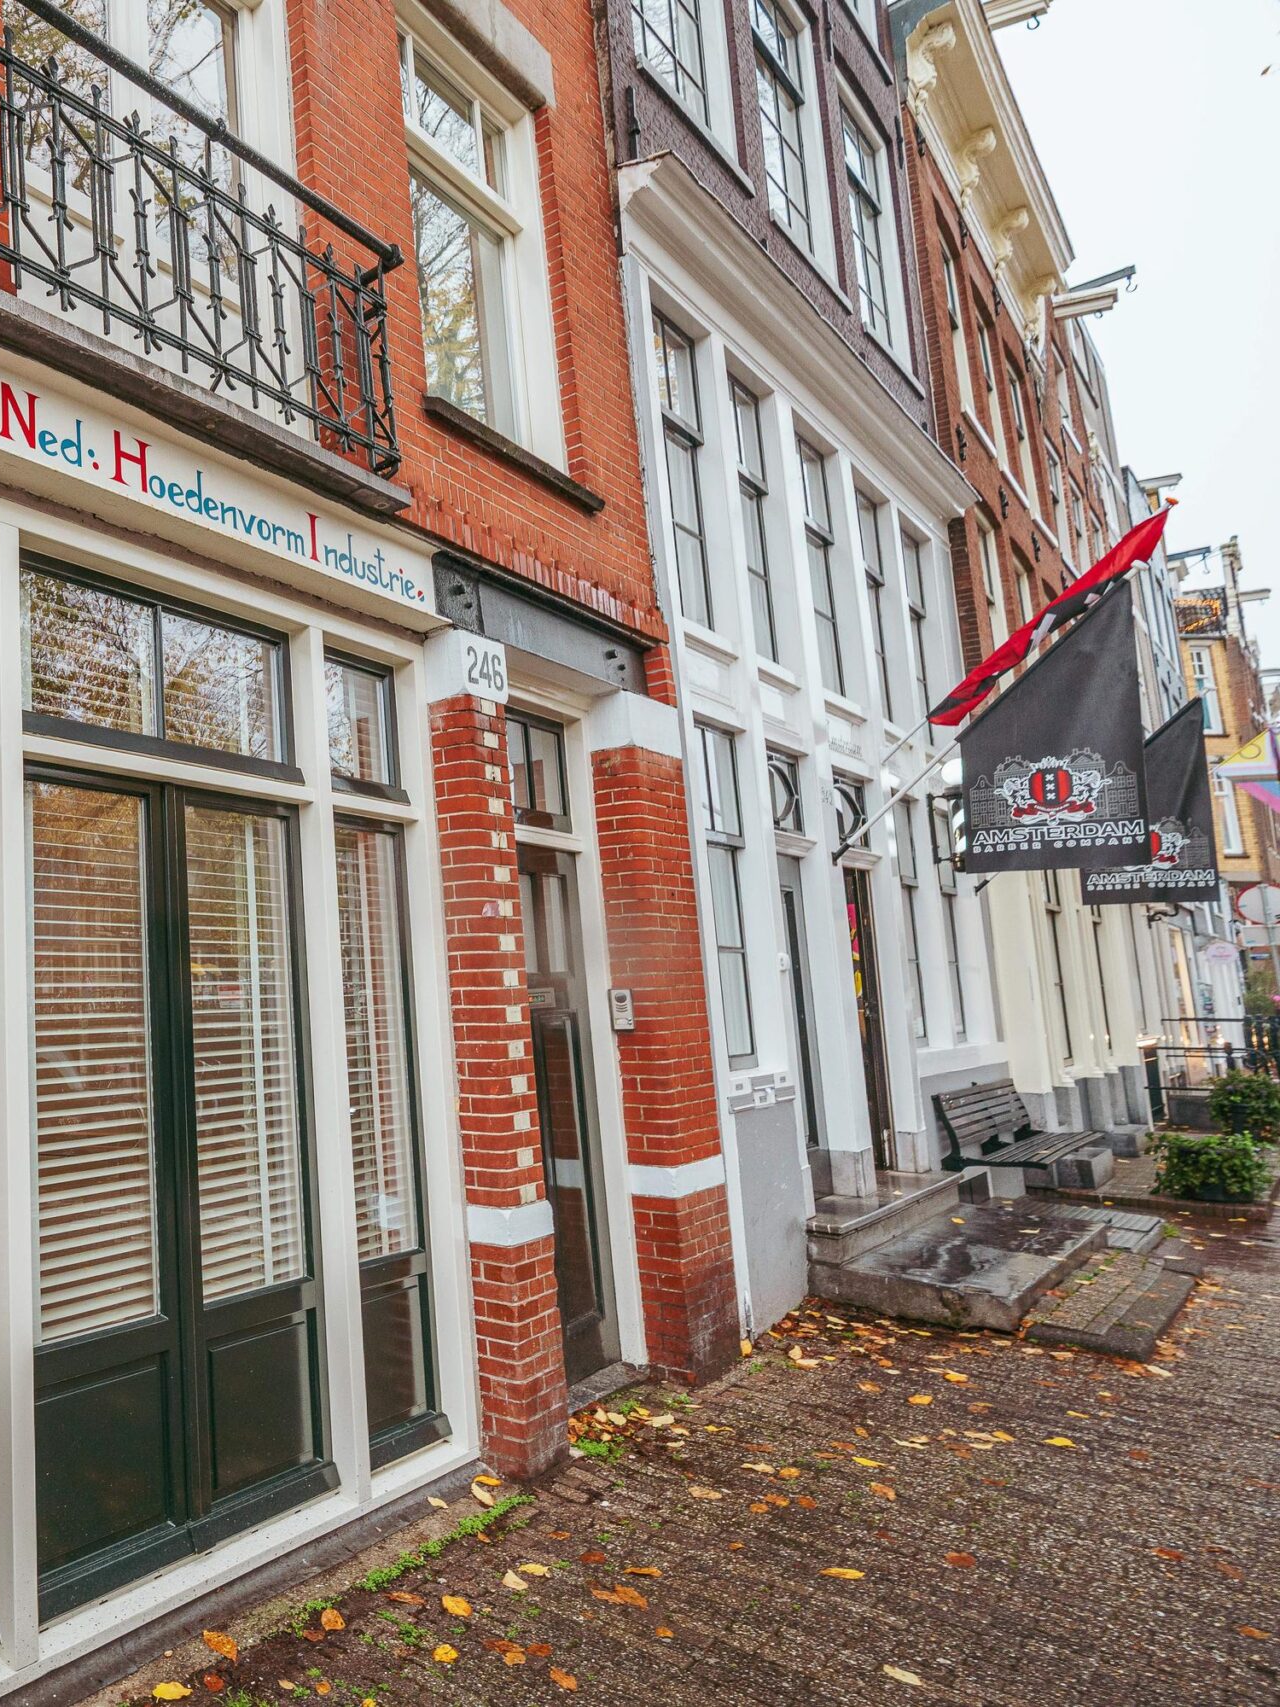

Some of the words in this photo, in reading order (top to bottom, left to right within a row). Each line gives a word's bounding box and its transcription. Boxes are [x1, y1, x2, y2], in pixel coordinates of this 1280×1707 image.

[110, 429, 306, 557] Hoedenvorm
[466, 645, 504, 692] 246
[972, 819, 1145, 846] AMSTERDAM
[972, 842, 1042, 854] BARBER
[1053, 834, 1146, 849] COMPANY
[1086, 868, 1215, 885] AMSTERDAM
